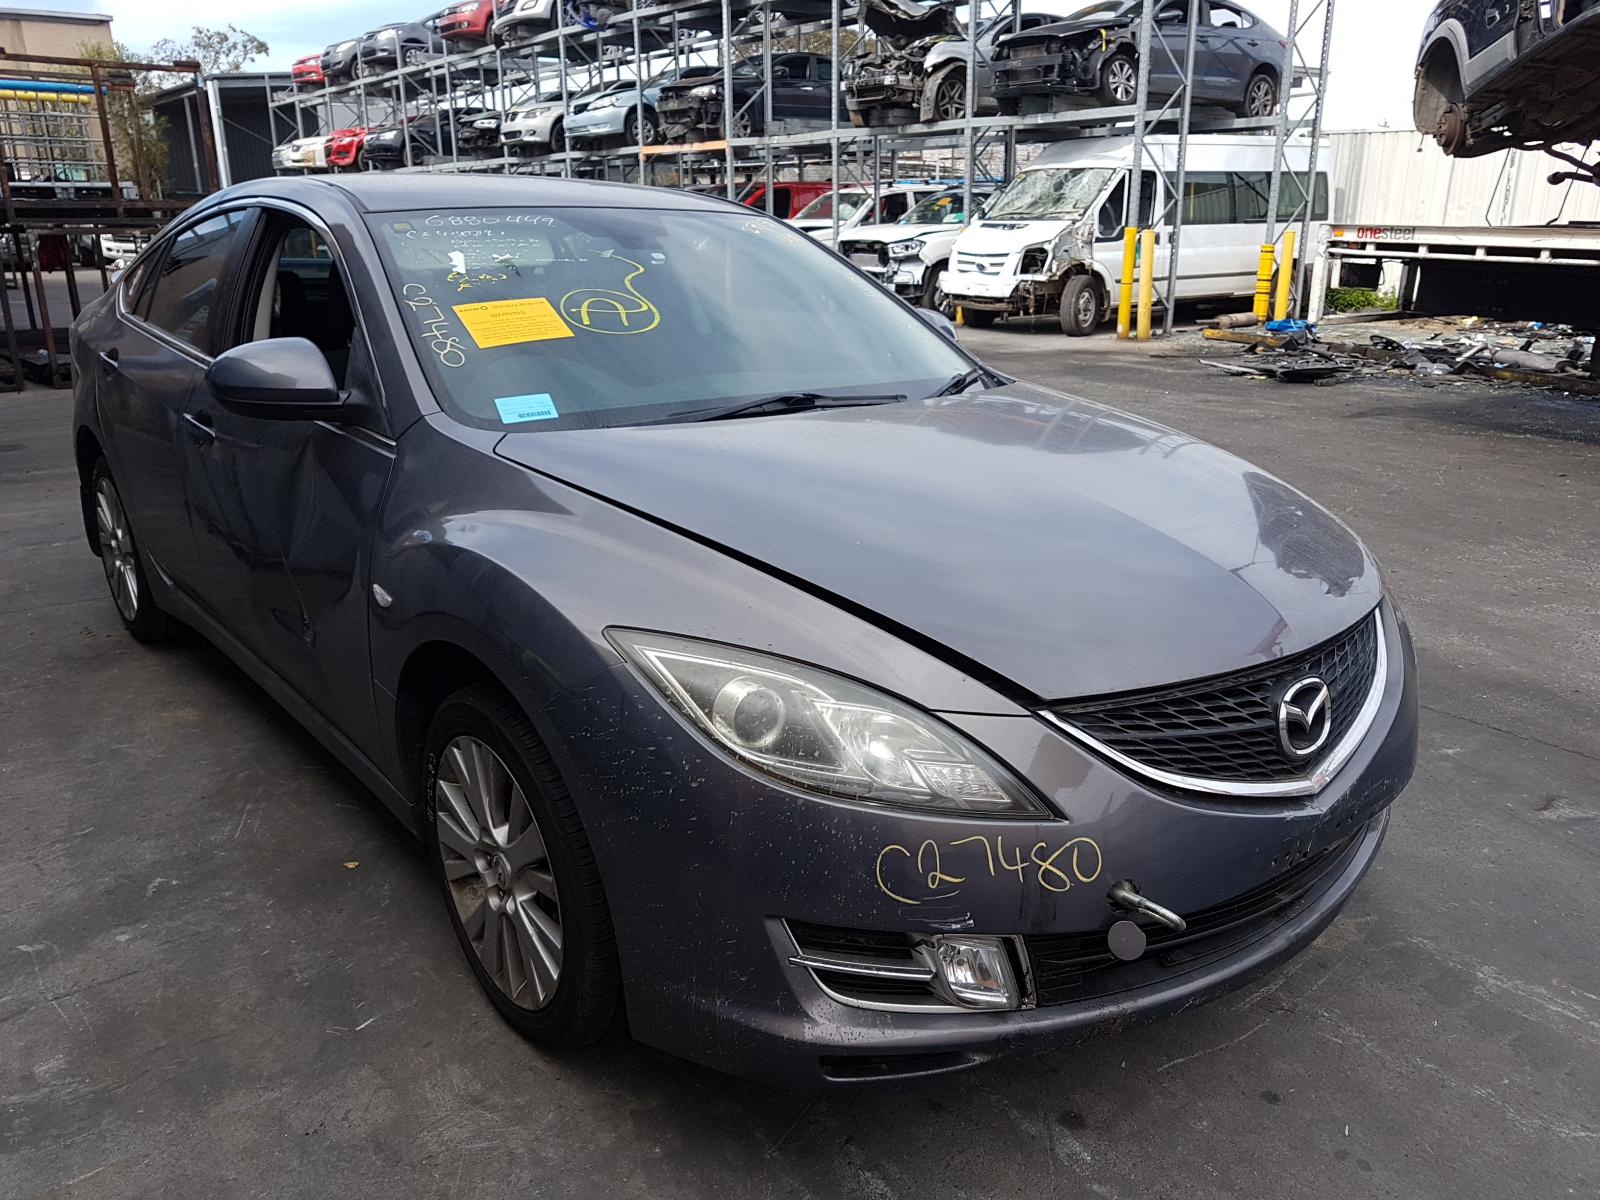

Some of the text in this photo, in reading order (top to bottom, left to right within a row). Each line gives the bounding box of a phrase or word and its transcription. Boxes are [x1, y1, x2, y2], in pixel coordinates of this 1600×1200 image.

[1356, 226, 1416, 241] onesteel
[403, 283, 466, 367] C27480
[876, 836, 1102, 904] C27480
